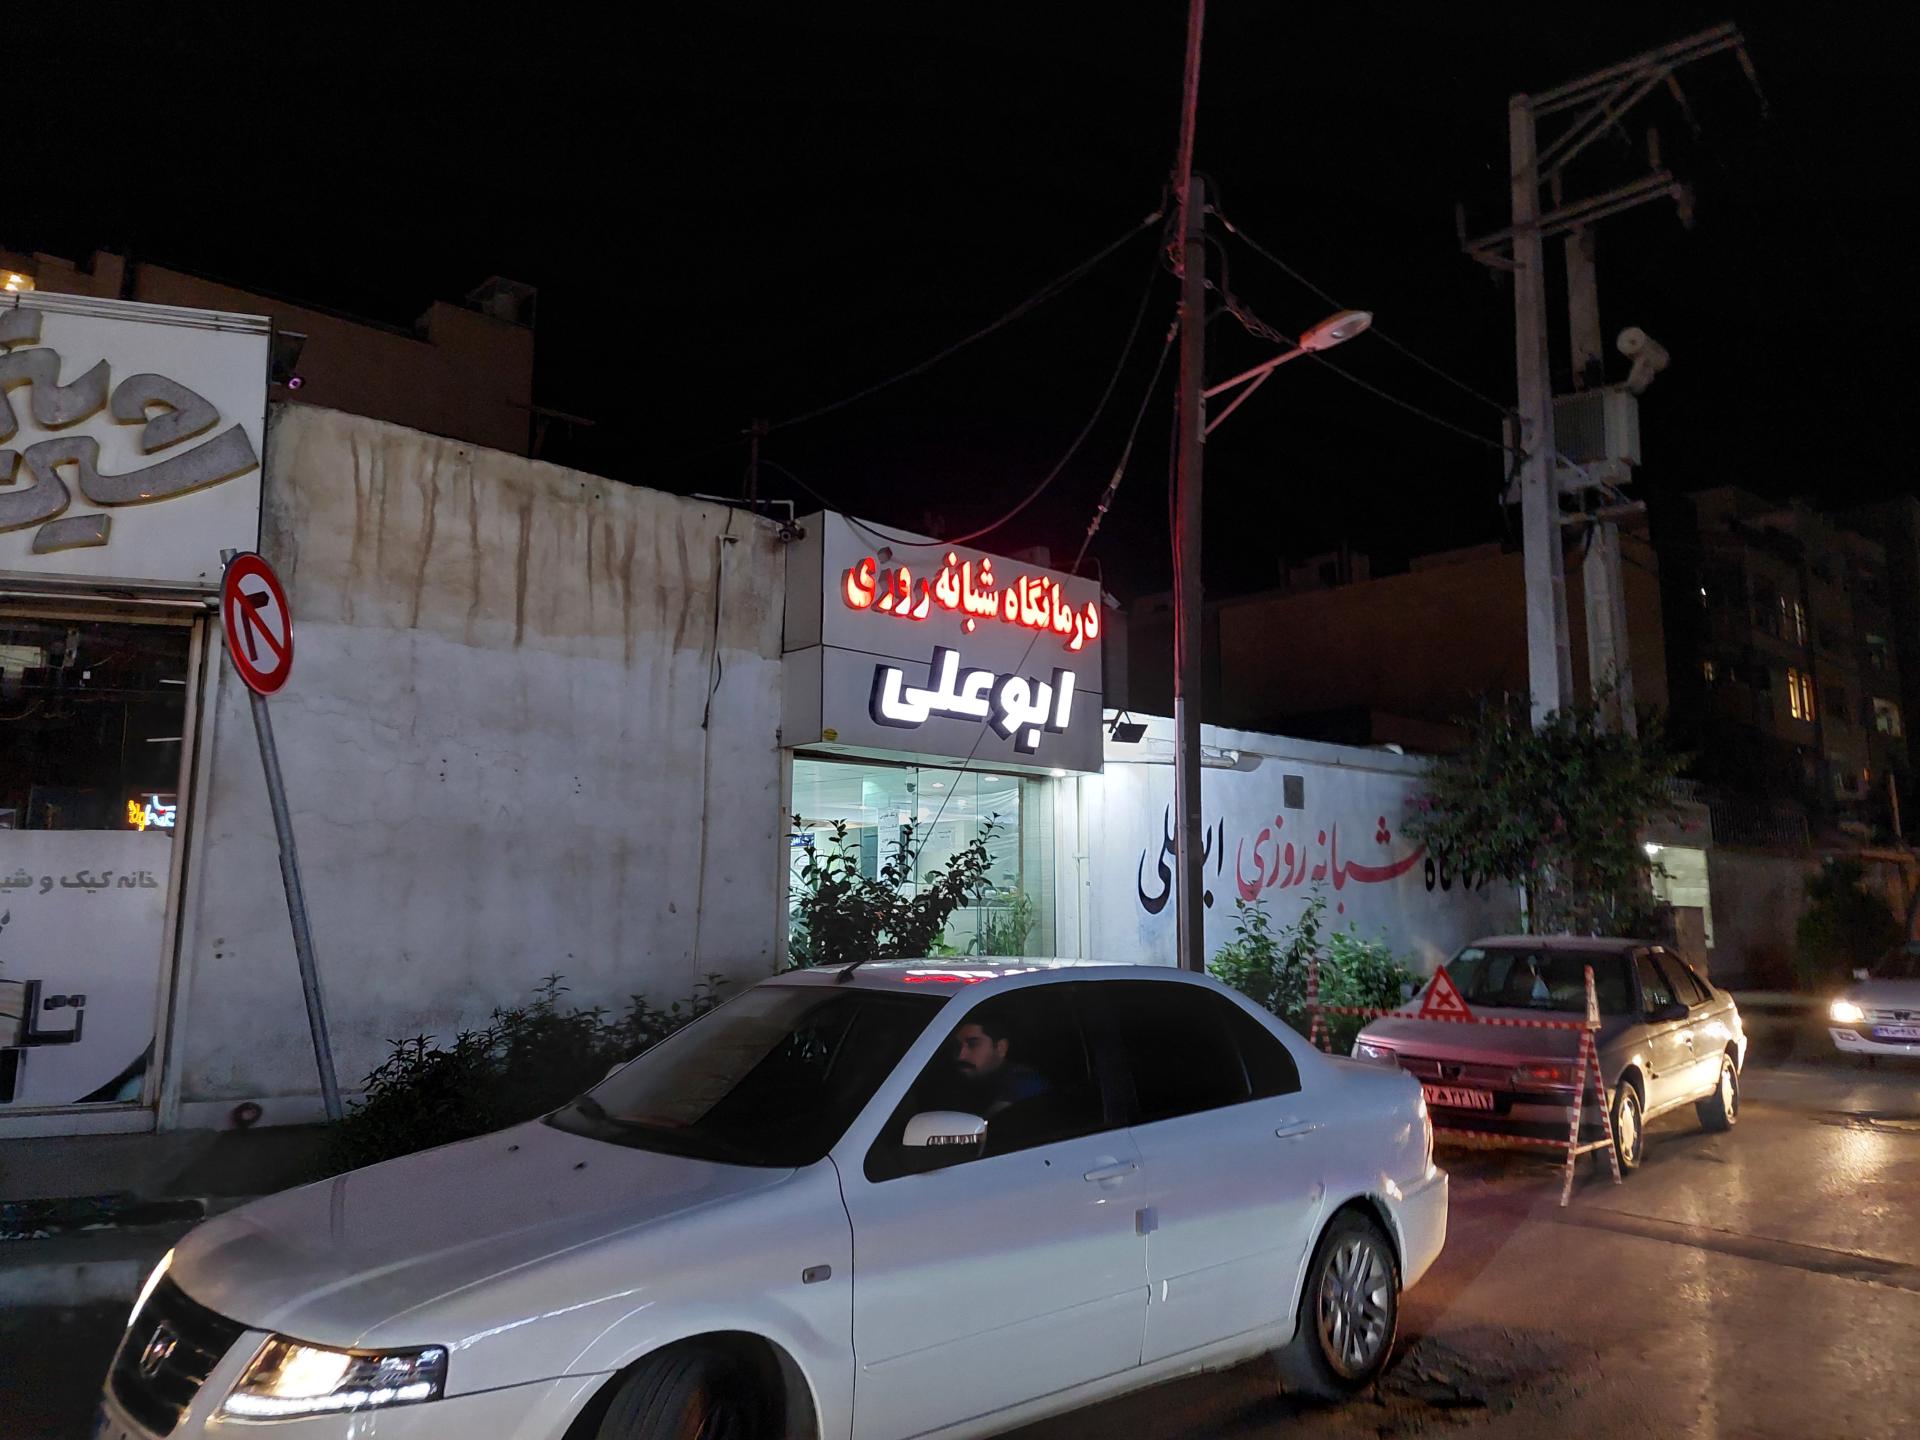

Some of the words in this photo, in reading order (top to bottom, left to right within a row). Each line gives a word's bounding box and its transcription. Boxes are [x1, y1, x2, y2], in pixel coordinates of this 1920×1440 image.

[841, 546, 931, 622] روزی
[932, 551, 999, 635] شبانه
[1001, 574, 1100, 650] درمانگاه
[38, 875, 54, 895] و
[60, 869, 113, 894] کیک
[117, 870, 159, 889] خانه
[1236, 814, 1307, 902] روزی
[1311, 815, 1426, 914] شبانه
